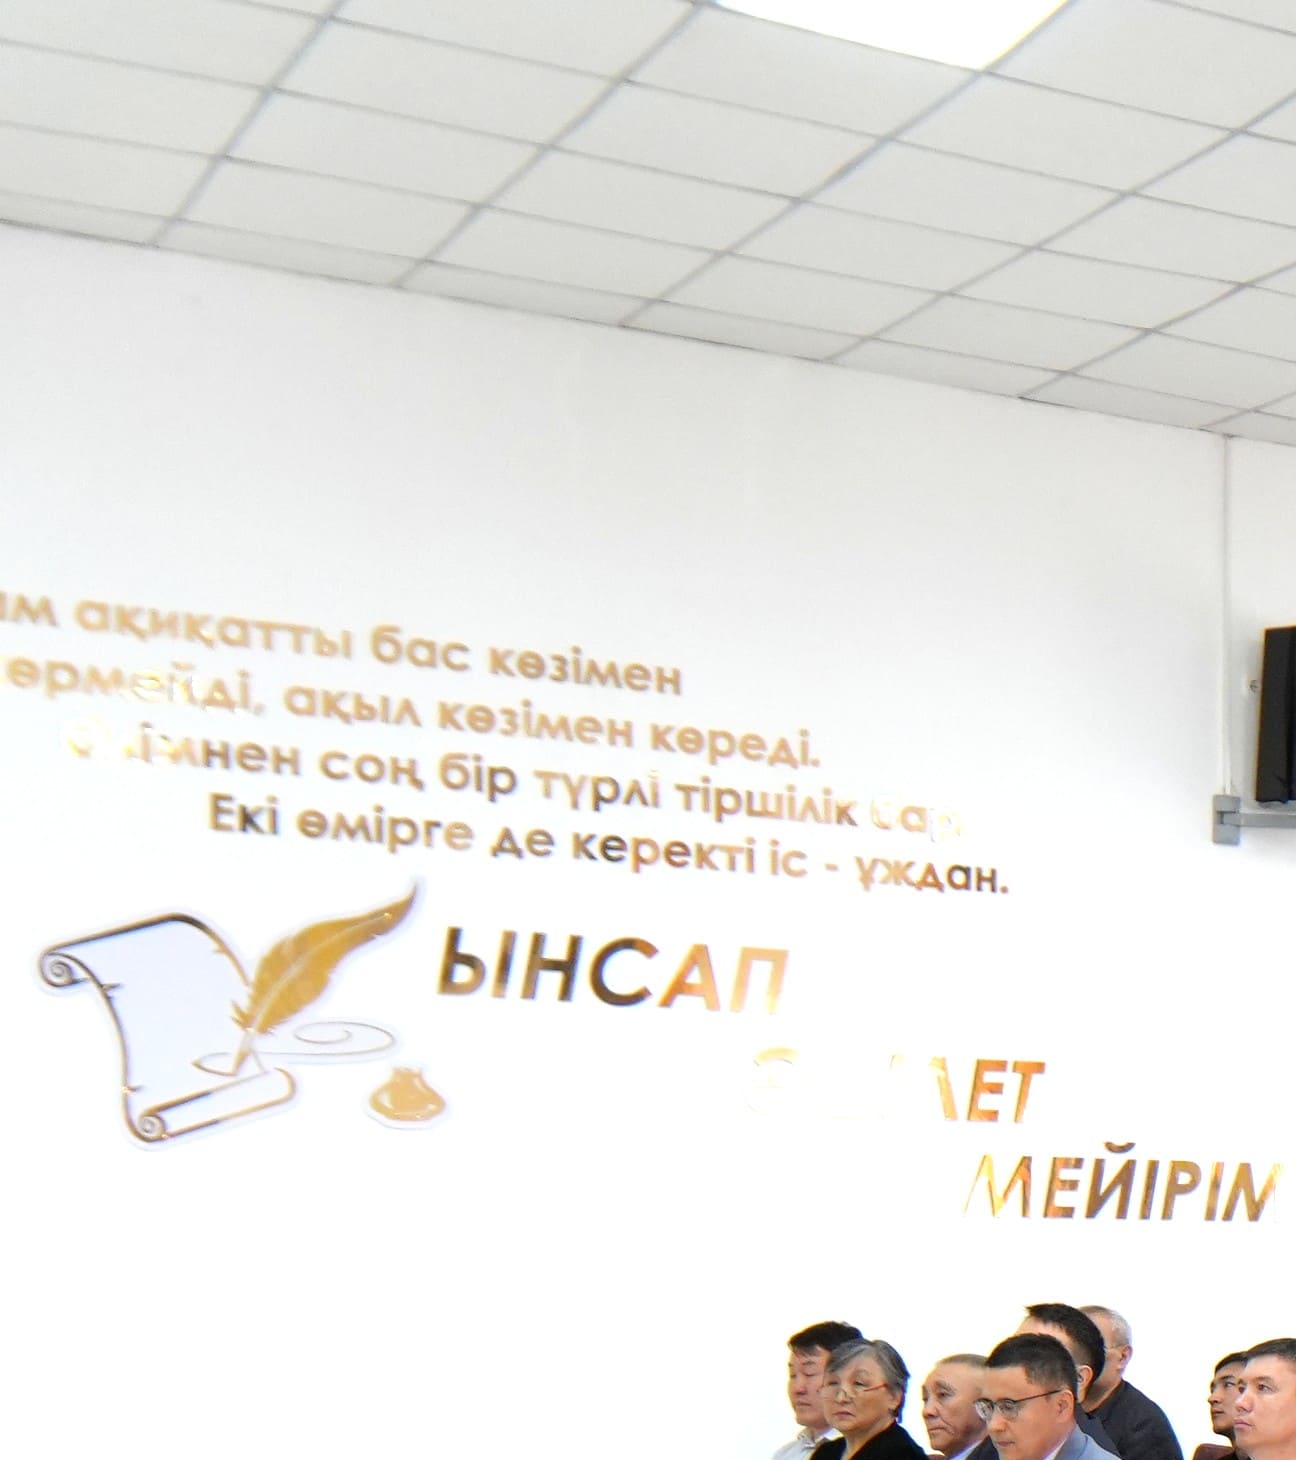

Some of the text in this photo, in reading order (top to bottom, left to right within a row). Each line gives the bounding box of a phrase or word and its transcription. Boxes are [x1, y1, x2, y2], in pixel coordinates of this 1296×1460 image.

[369, 624, 471, 672] бас
[488, 645, 682, 697] көзімен
[283, 685, 422, 728] ақыл
[437, 699, 634, 748] көзімен
[650, 722, 821, 769] көреді.
[317, 749, 425, 792] соң
[438, 752, 517, 802] бір
[533, 769, 661, 812] түрлі
[674, 775, 858, 827] тіршілік
[208, 792, 279, 837] Екі
[296, 803, 475, 855] өмірге
[490, 826, 556, 860] де
[571, 831, 757, 875] керекті
[769, 838, 809, 879] іс
[436, 925, 790, 1015] ЫНСАП
